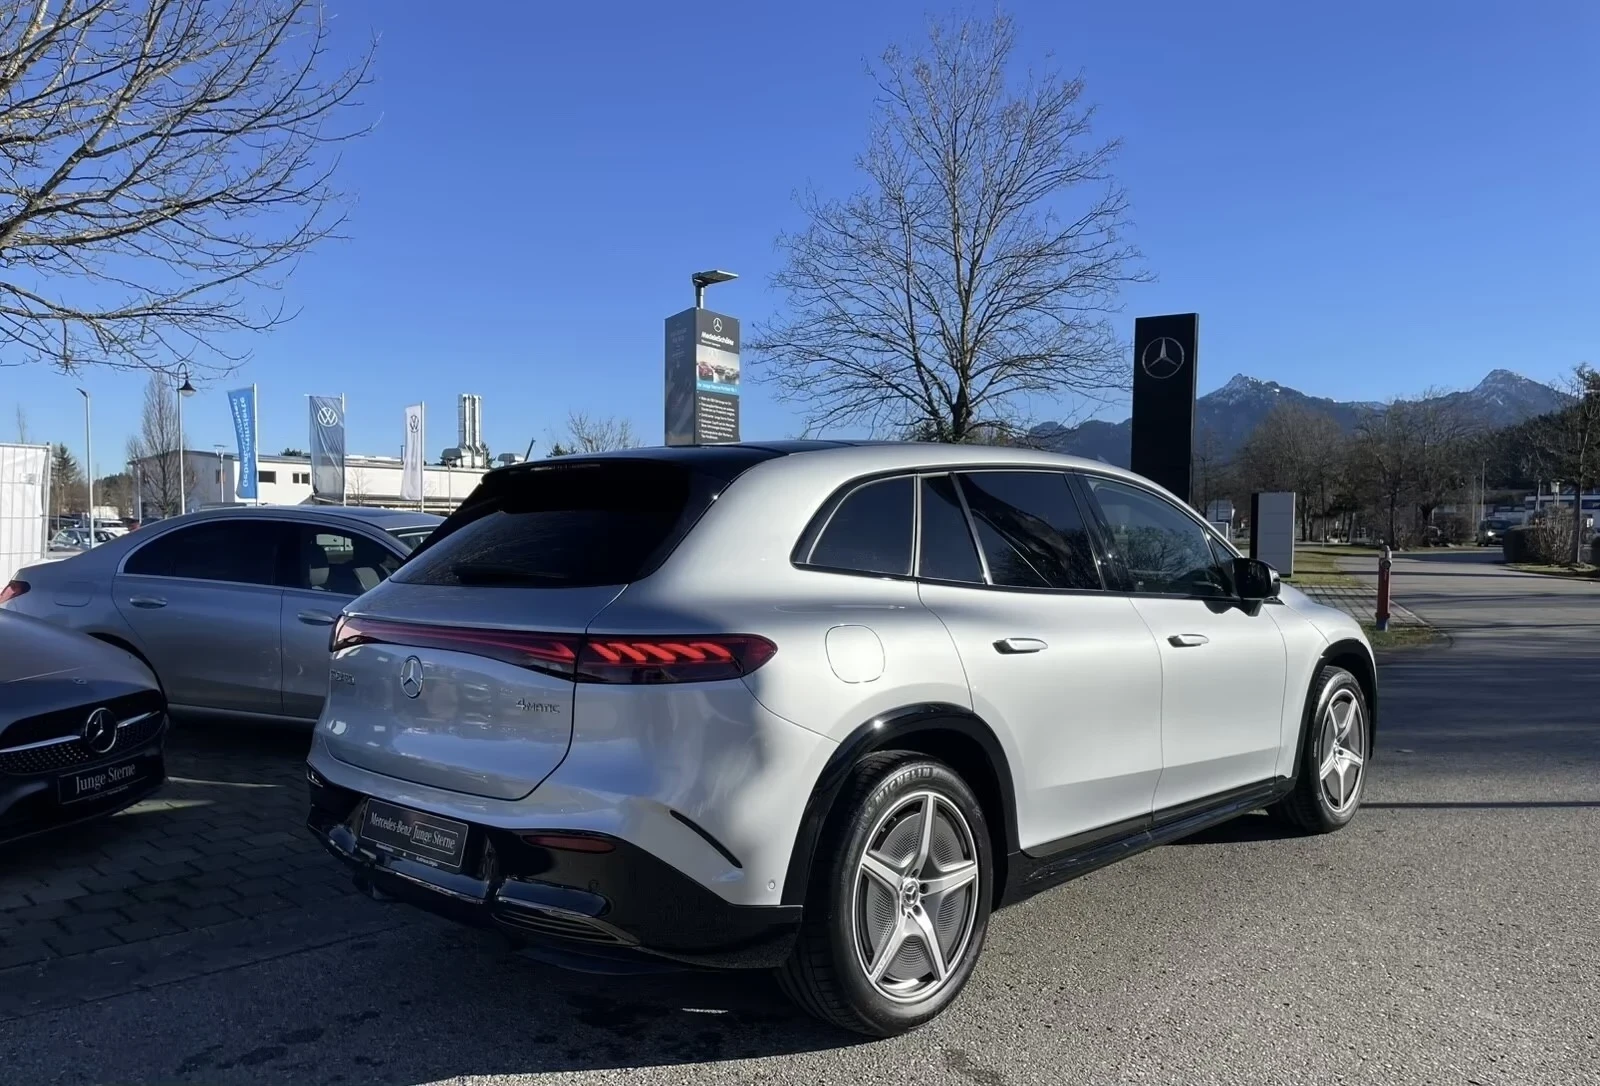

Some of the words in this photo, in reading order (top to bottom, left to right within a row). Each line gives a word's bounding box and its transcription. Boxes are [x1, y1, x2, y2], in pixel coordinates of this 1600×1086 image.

[76, 773, 106, 794] Junge
[108, 763, 136, 783] Sterne
[875, 767, 931, 806] MICHELIN
[370, 811, 413, 836] Mercedes-Benz
[413, 825, 432, 844] Junge
[432, 830, 456, 850] Sterne
